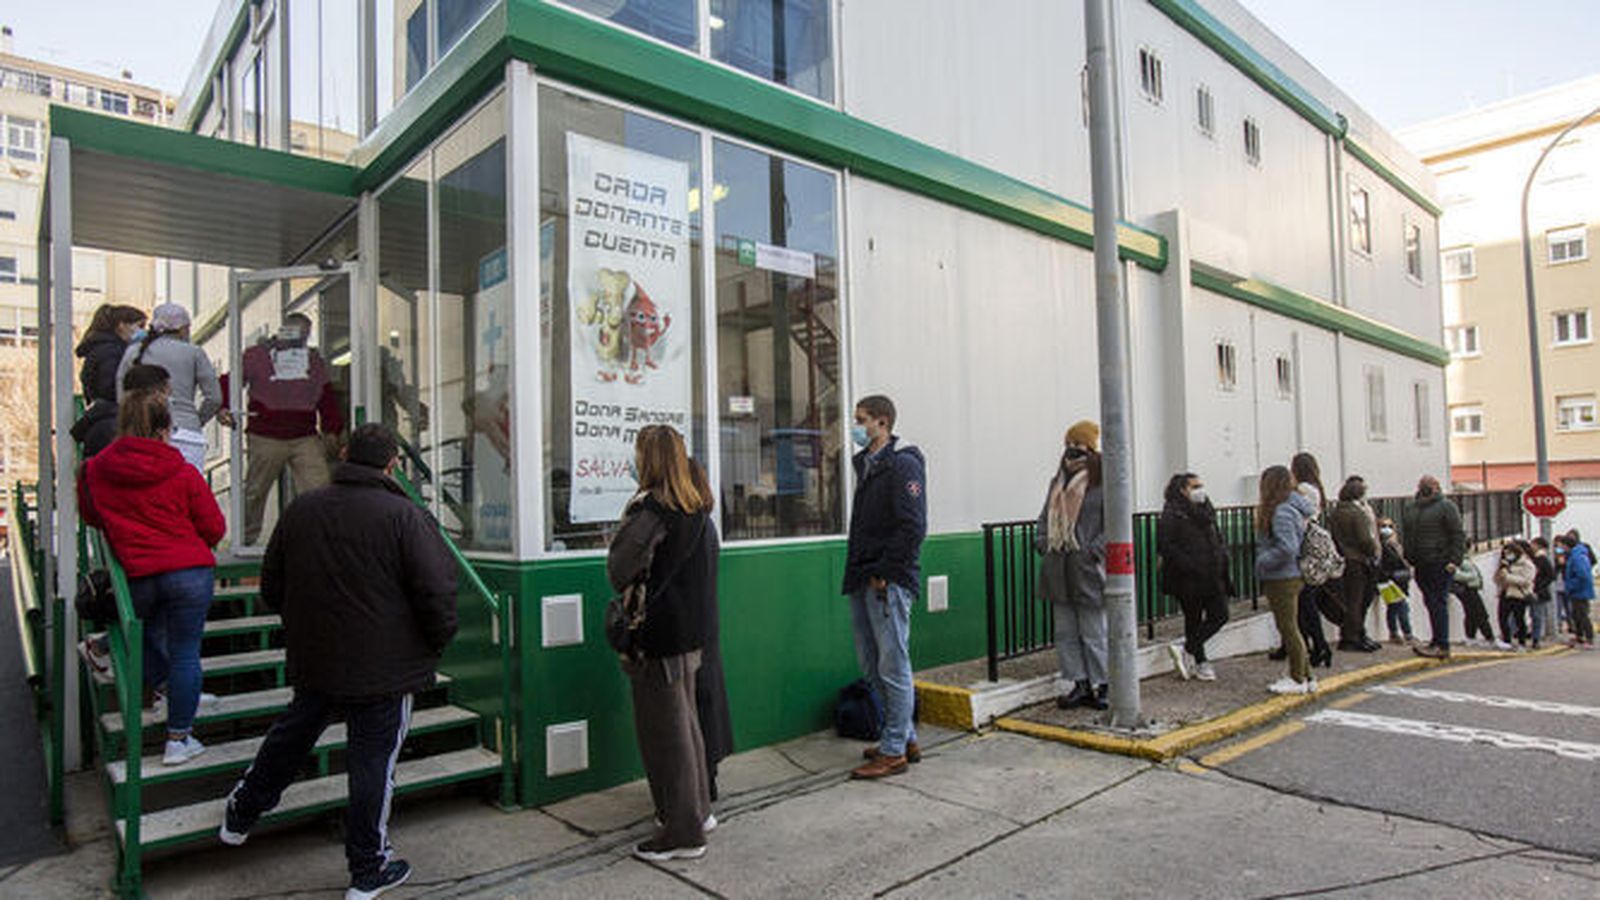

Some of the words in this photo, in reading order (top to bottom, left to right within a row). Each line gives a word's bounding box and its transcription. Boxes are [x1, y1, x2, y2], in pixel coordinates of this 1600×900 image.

[594, 172, 667, 206] CADA
[575, 198, 683, 236] DONANTE
[584, 229, 677, 262] CUENTA
[1527, 496, 1562, 506] STOP
